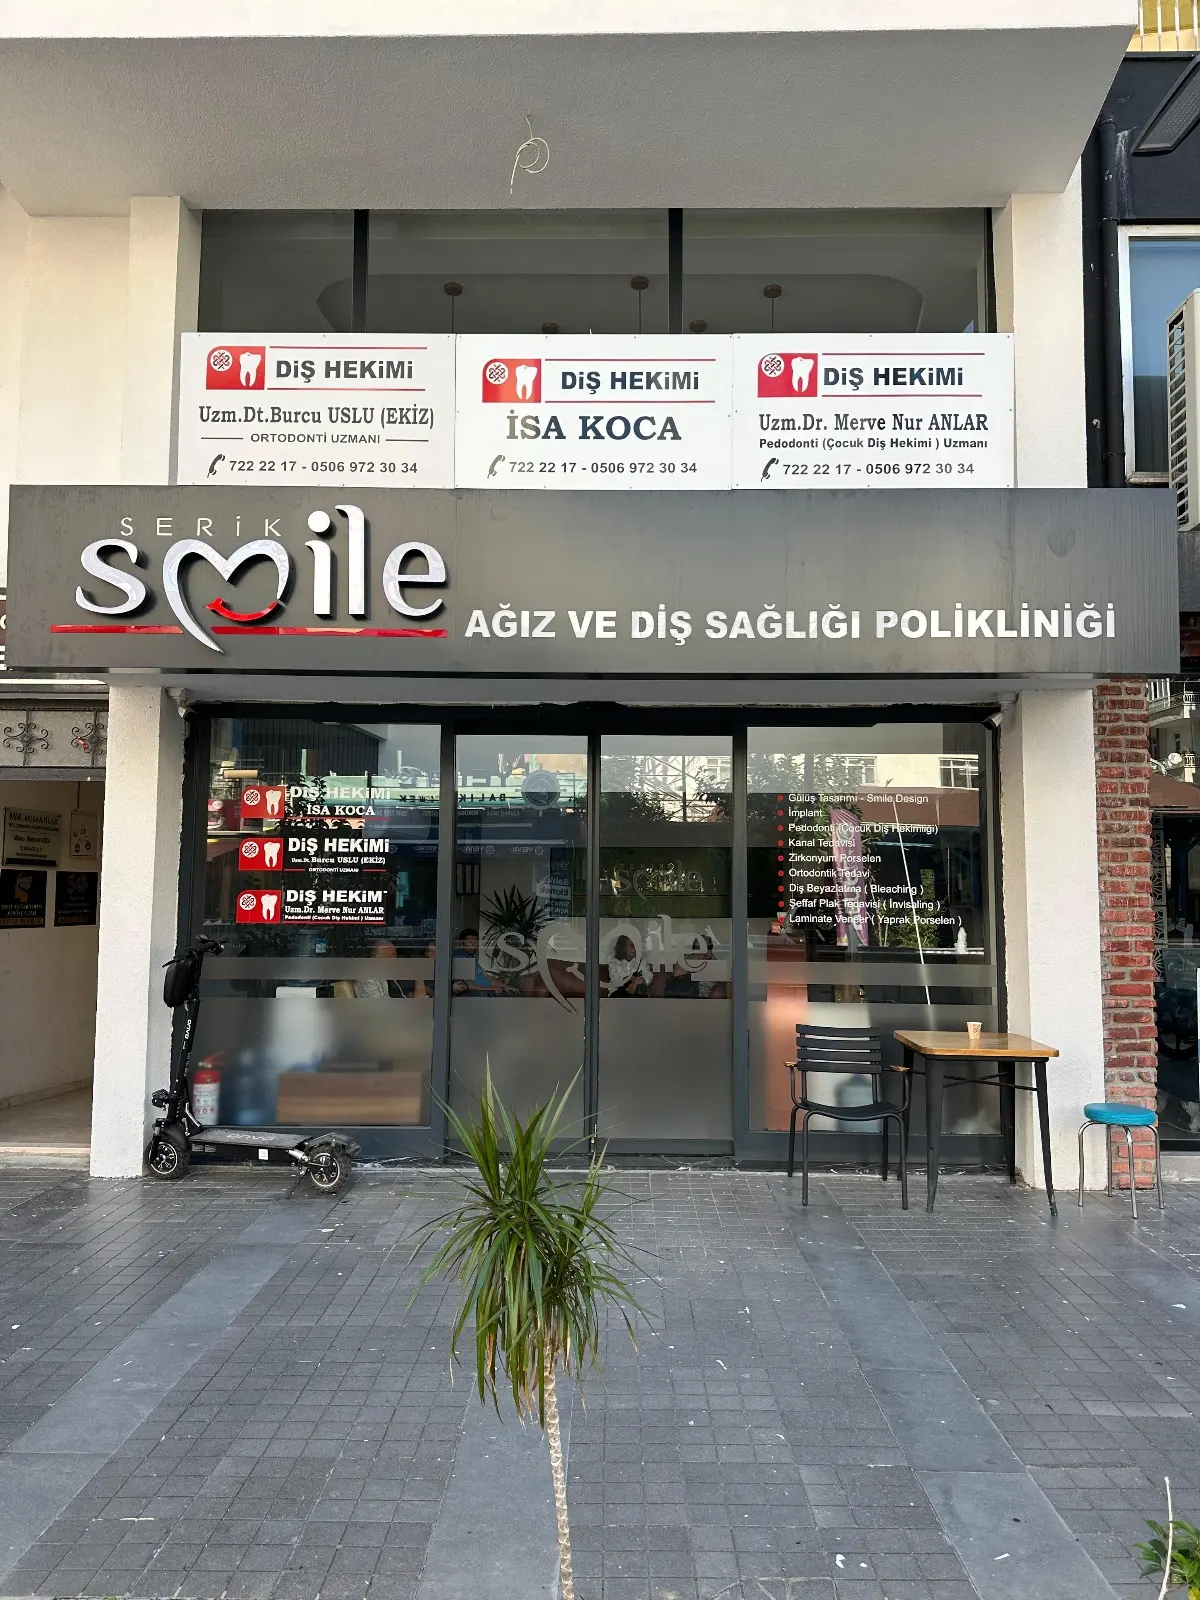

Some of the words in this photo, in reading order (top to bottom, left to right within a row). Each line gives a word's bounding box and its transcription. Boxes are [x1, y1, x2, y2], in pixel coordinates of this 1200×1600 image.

[199, 405, 321, 424] Uzm.Dt.Burcu
[328, 406, 374, 424] USLU
[380, 403, 434, 429] (EKİZ)
[758, 413, 828, 431] Uzm.Dr.
[834, 413, 885, 431] Merve
[892, 413, 923, 431] Nur
[928, 413, 989, 431] ANLAR
[507, 409, 566, 440] İSA
[579, 415, 682, 441] KOCA
[250, 431, 327, 443] ORTODONTİ
[331, 434, 381, 444] UZMANI
[759, 438, 819, 449] Pedodonti
[822, 437, 863, 450] (Çocuk
[867, 437, 885, 450] Diş
[890, 437, 932, 449] Hekimi
[943, 437, 988, 449] Uzmanı
[229, 460, 254, 472] 722
[258, 460, 276, 472] 22
[281, 460, 297, 472] 17
[311, 461, 345, 473] 0506
[349, 461, 375, 473] 972
[379, 461, 396, 473] 30
[400, 462, 418, 474] 34
[509, 461, 534, 473] 722
[538, 462, 556, 473] 22
[560, 462, 577, 473] 17
[591, 462, 625, 474] 0506
[629, 462, 655, 474] 972
[659, 462, 676, 474] 30
[680, 462, 698, 474] 34
[782, 464, 809, 475] 722
[812, 463, 830, 475] 22
[835, 463, 852, 475] 17
[865, 463, 901, 475] 0506
[904, 463, 931, 475] 972
[935, 463, 953, 474] 30
[957, 462, 975, 474] 34
[464, 602, 556, 638] AĞIZ
[568, 610, 617, 639] VE
[631, 603, 692, 646] DİŞ
[705, 603, 860, 639] SAĞLIĞI
[876, 602, 1116, 639] POLİKLİNİĞİ
[788, 793, 816, 804] Gülüş
[819, 794, 858, 803] Tasarımı
[866, 794, 893, 803] Smile
[895, 794, 929, 805] Design
[306, 802, 331, 815] İSA
[335, 804, 376, 816] KOCA
[788, 807, 823, 818] İmplant
[788, 823, 836, 832] Pedodonti
[838, 823, 872, 835] (Çocuk
[873, 823, 889, 835] Diş
[788, 838, 816, 847] Kanal
[818, 838, 856, 847] Tedavisi
[337, 856, 360, 864] USLU
[788, 853, 837, 864] Zirkonyum
[840, 854, 882, 863] Porselen
[788, 868, 837, 878] Ortodontik
[839, 868, 870, 878] Tedavi
[789, 884, 805, 894] Diş
[870, 885, 917, 896] Bleaching
[285, 905, 316, 914] Uzm.Dr.
[317, 906, 340, 914] Merve
[342, 906, 356, 914] Nur
[358, 906, 385, 914] ANLAR
[789, 899, 817, 910] Şeffaf
[819, 899, 840, 908] Plak
[842, 900, 880, 909] Tedavisi
[789, 914, 833, 924] Laminate
[835, 915, 869, 924] Veneer
[877, 915, 910, 926] Yaprak
[913, 916, 956, 925] Porselen
